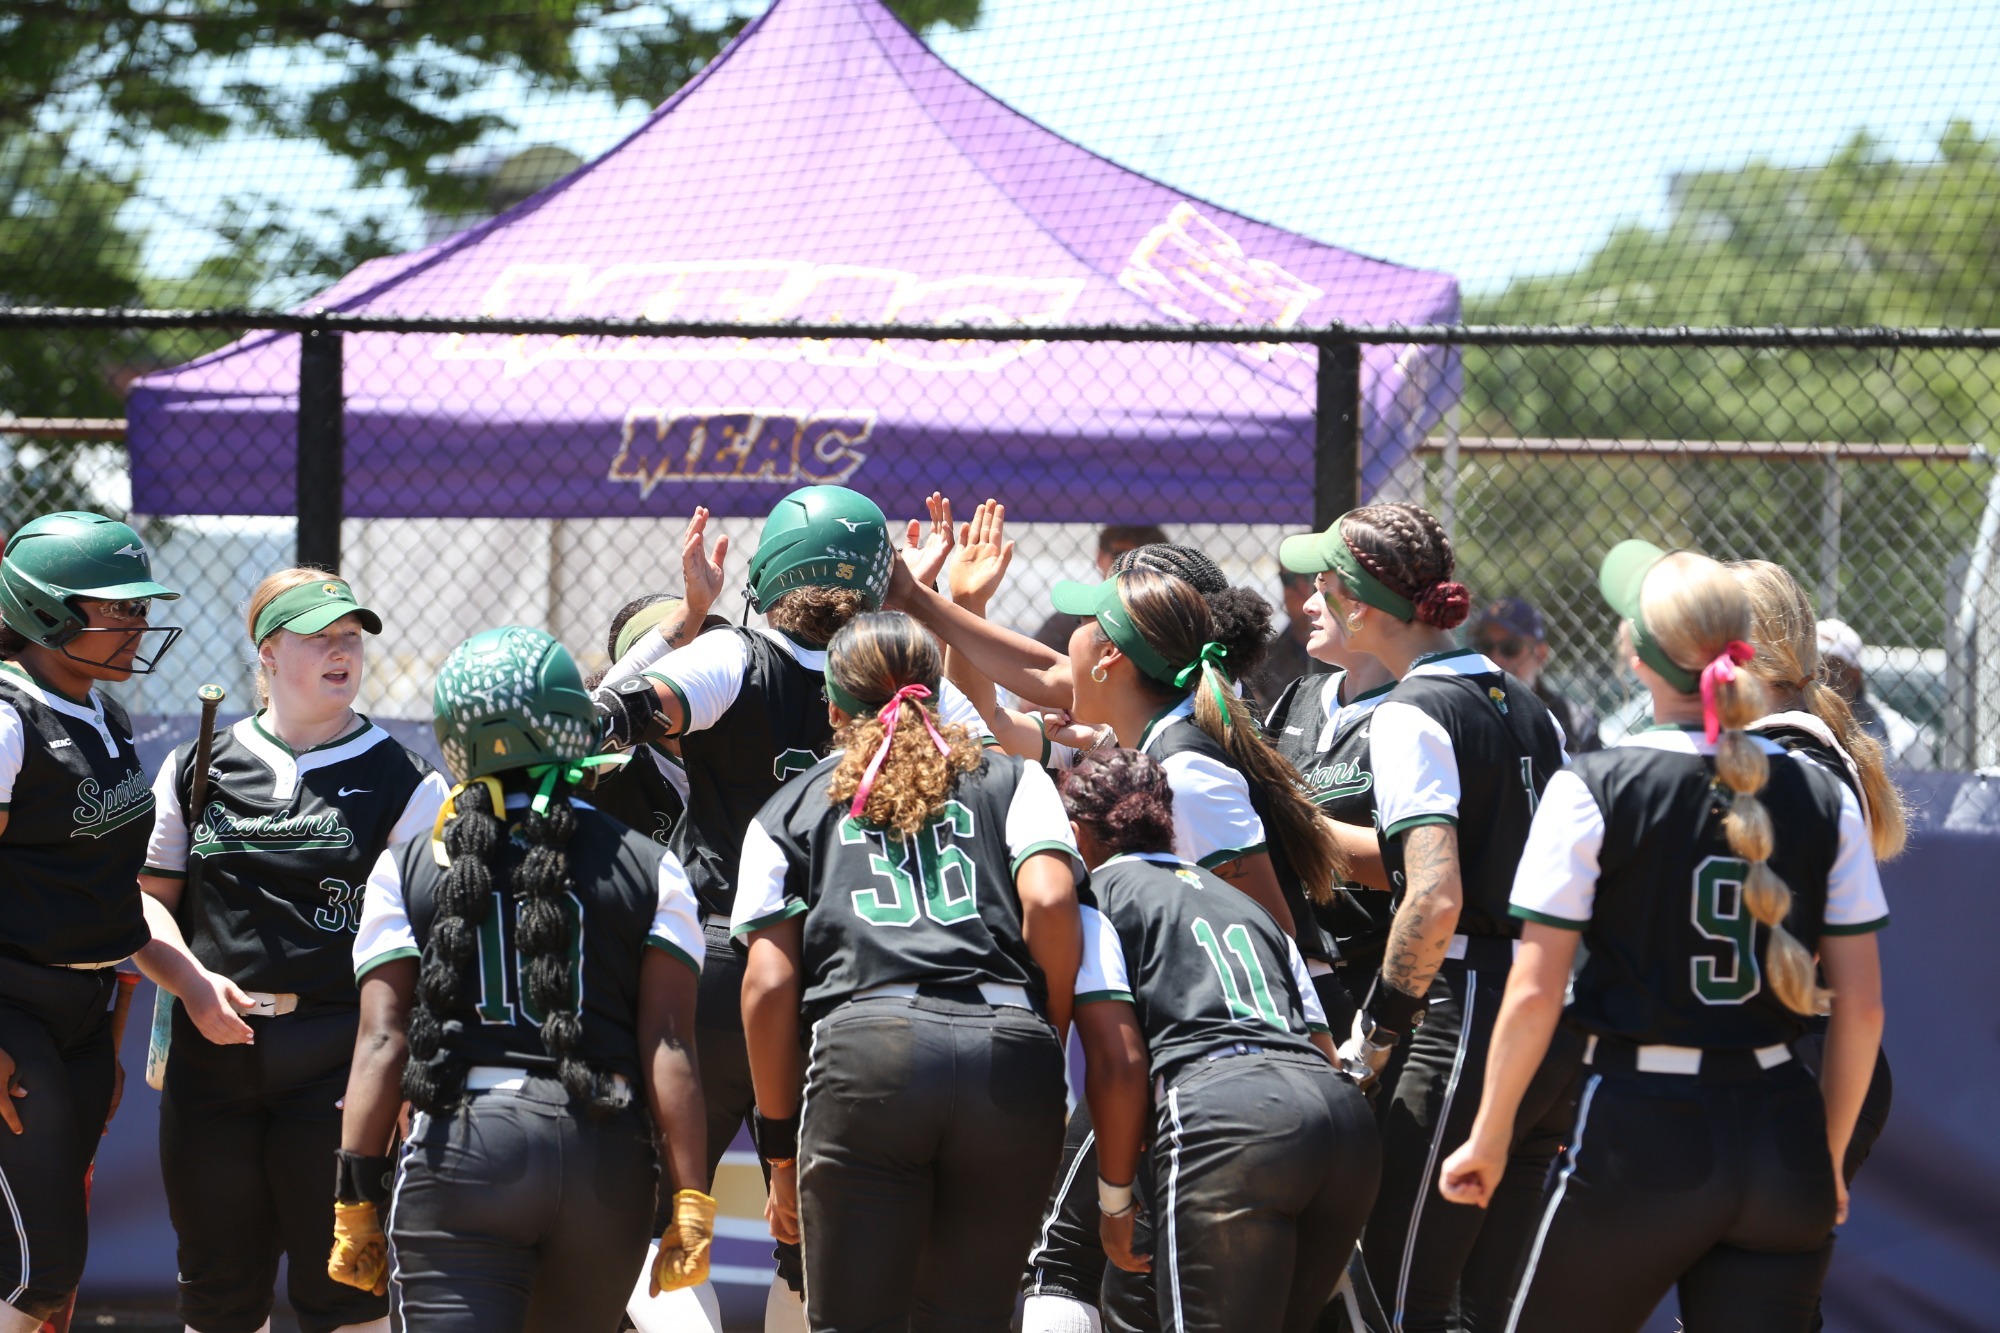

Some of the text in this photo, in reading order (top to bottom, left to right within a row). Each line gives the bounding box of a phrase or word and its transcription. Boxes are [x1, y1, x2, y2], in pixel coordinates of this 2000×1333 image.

[608, 408, 877, 498] MEAC
[835, 562, 855, 580] 35
[48, 738, 72, 749] MEAC
[194, 800, 349, 851] Spartans
[838, 799, 981, 927] 36
[1190, 916, 1290, 1033] 11
[1690, 855, 1761, 1005] 9
